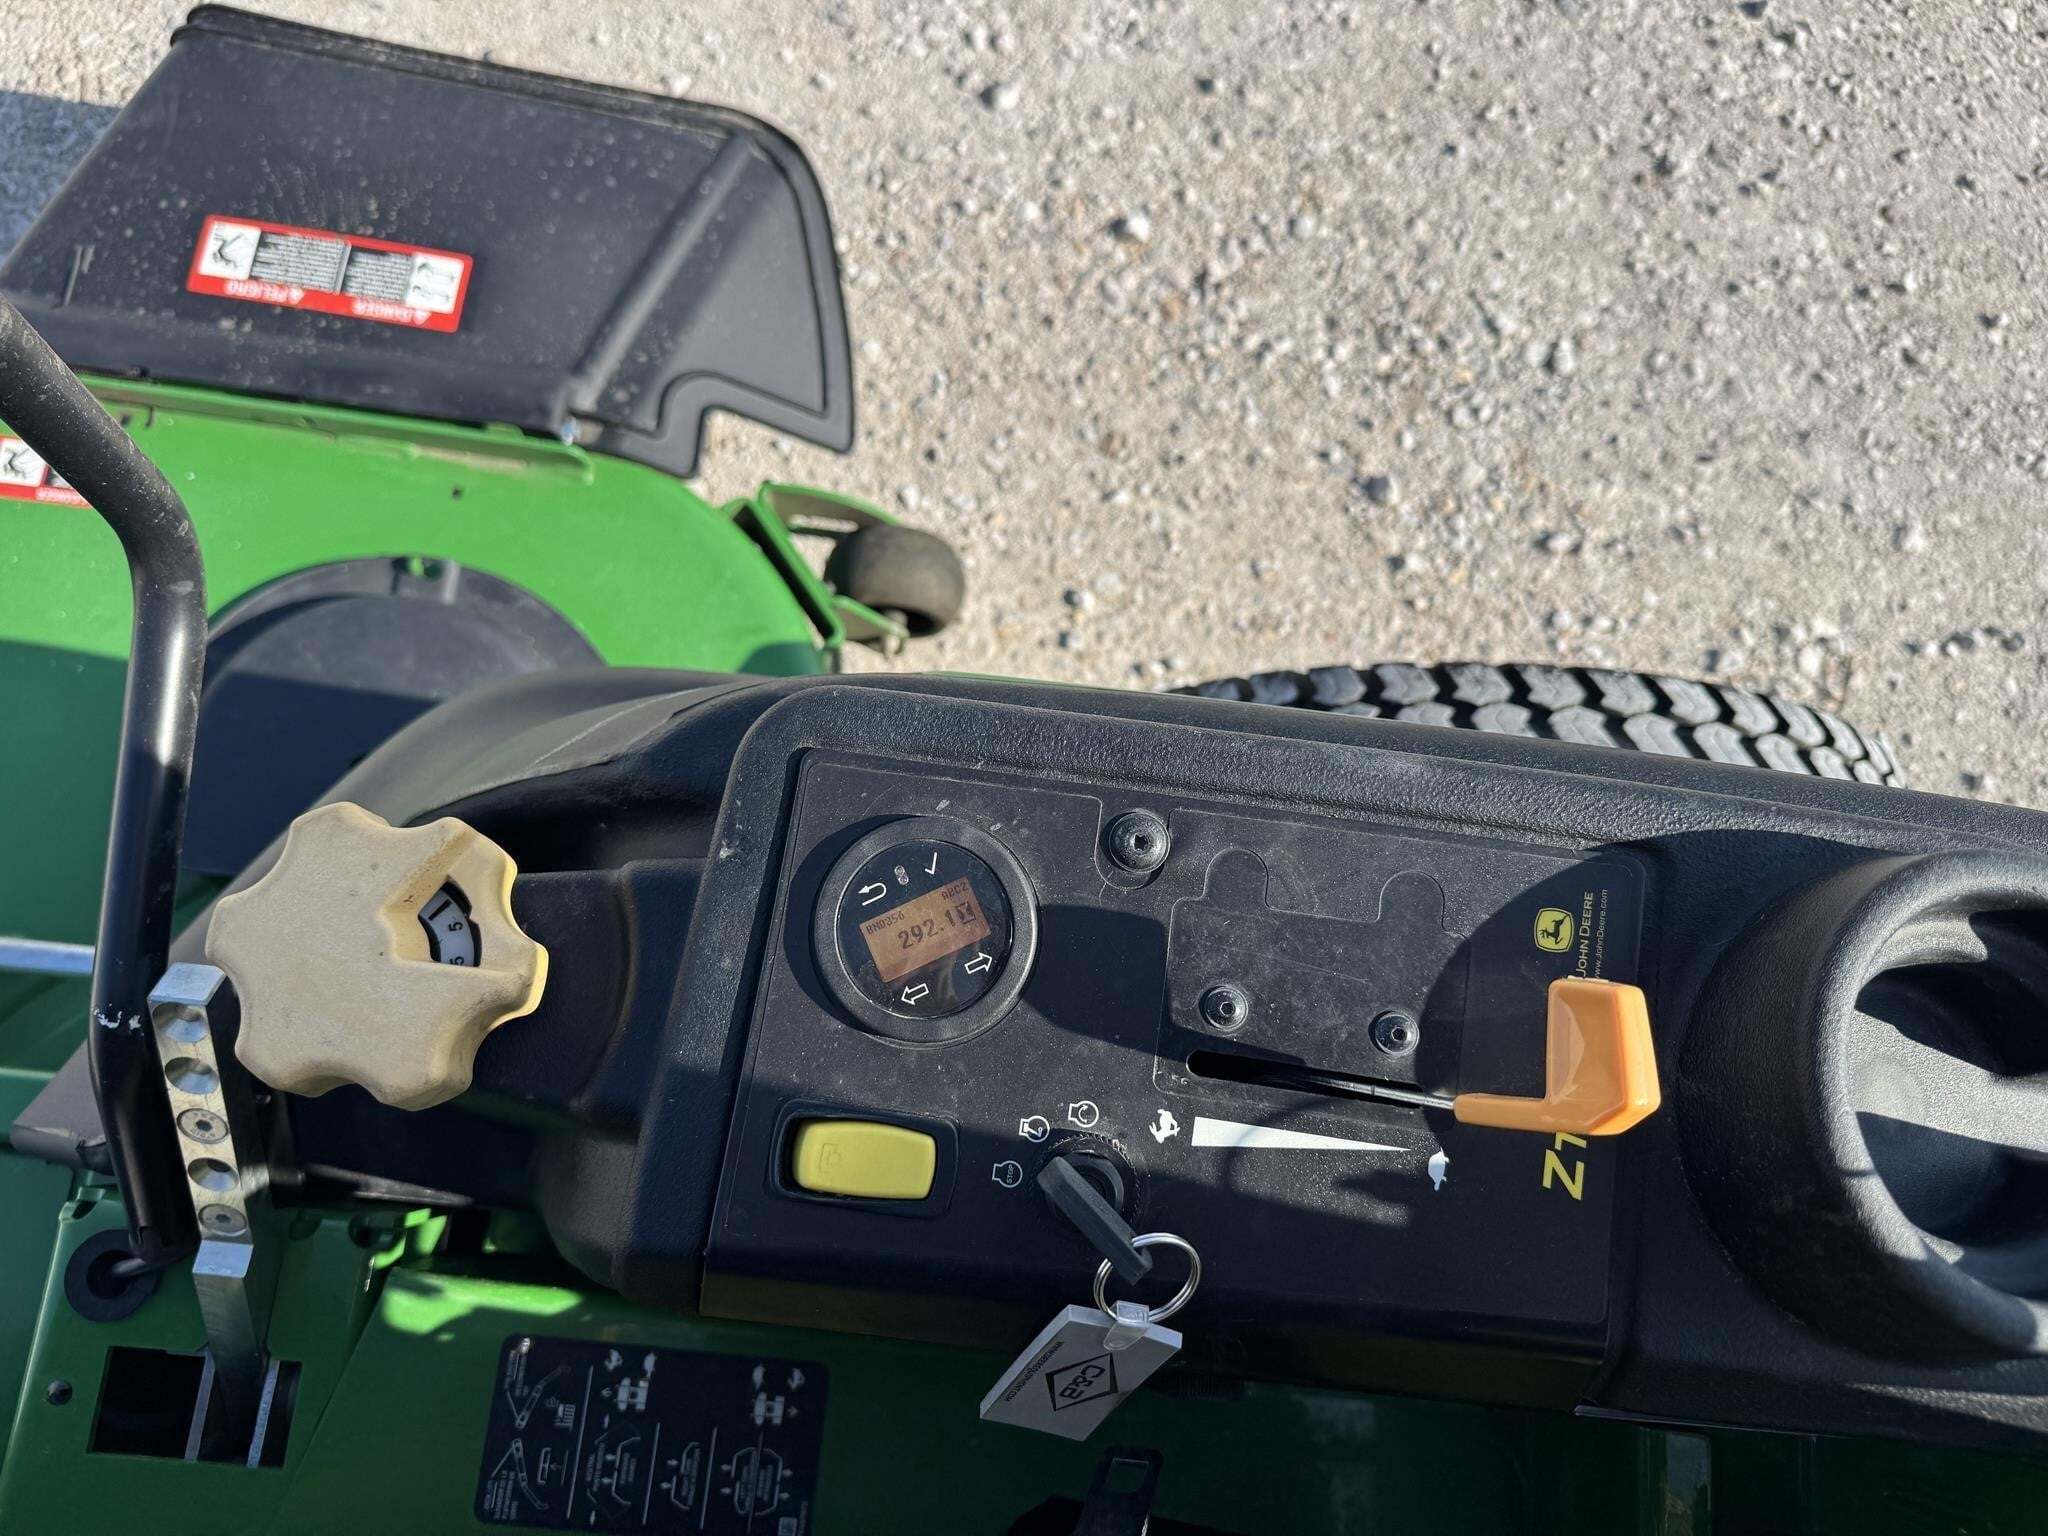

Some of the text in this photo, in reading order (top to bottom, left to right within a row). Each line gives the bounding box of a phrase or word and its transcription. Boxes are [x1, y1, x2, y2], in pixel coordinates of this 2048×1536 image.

[448, 921, 463, 932] 5
[897, 908, 956, 949] 292.1
[1576, 891, 1594, 977] JOHN DEERE
[1006, 1164, 1014, 1184] STOP
[1059, 1364, 1106, 1400] C&B
